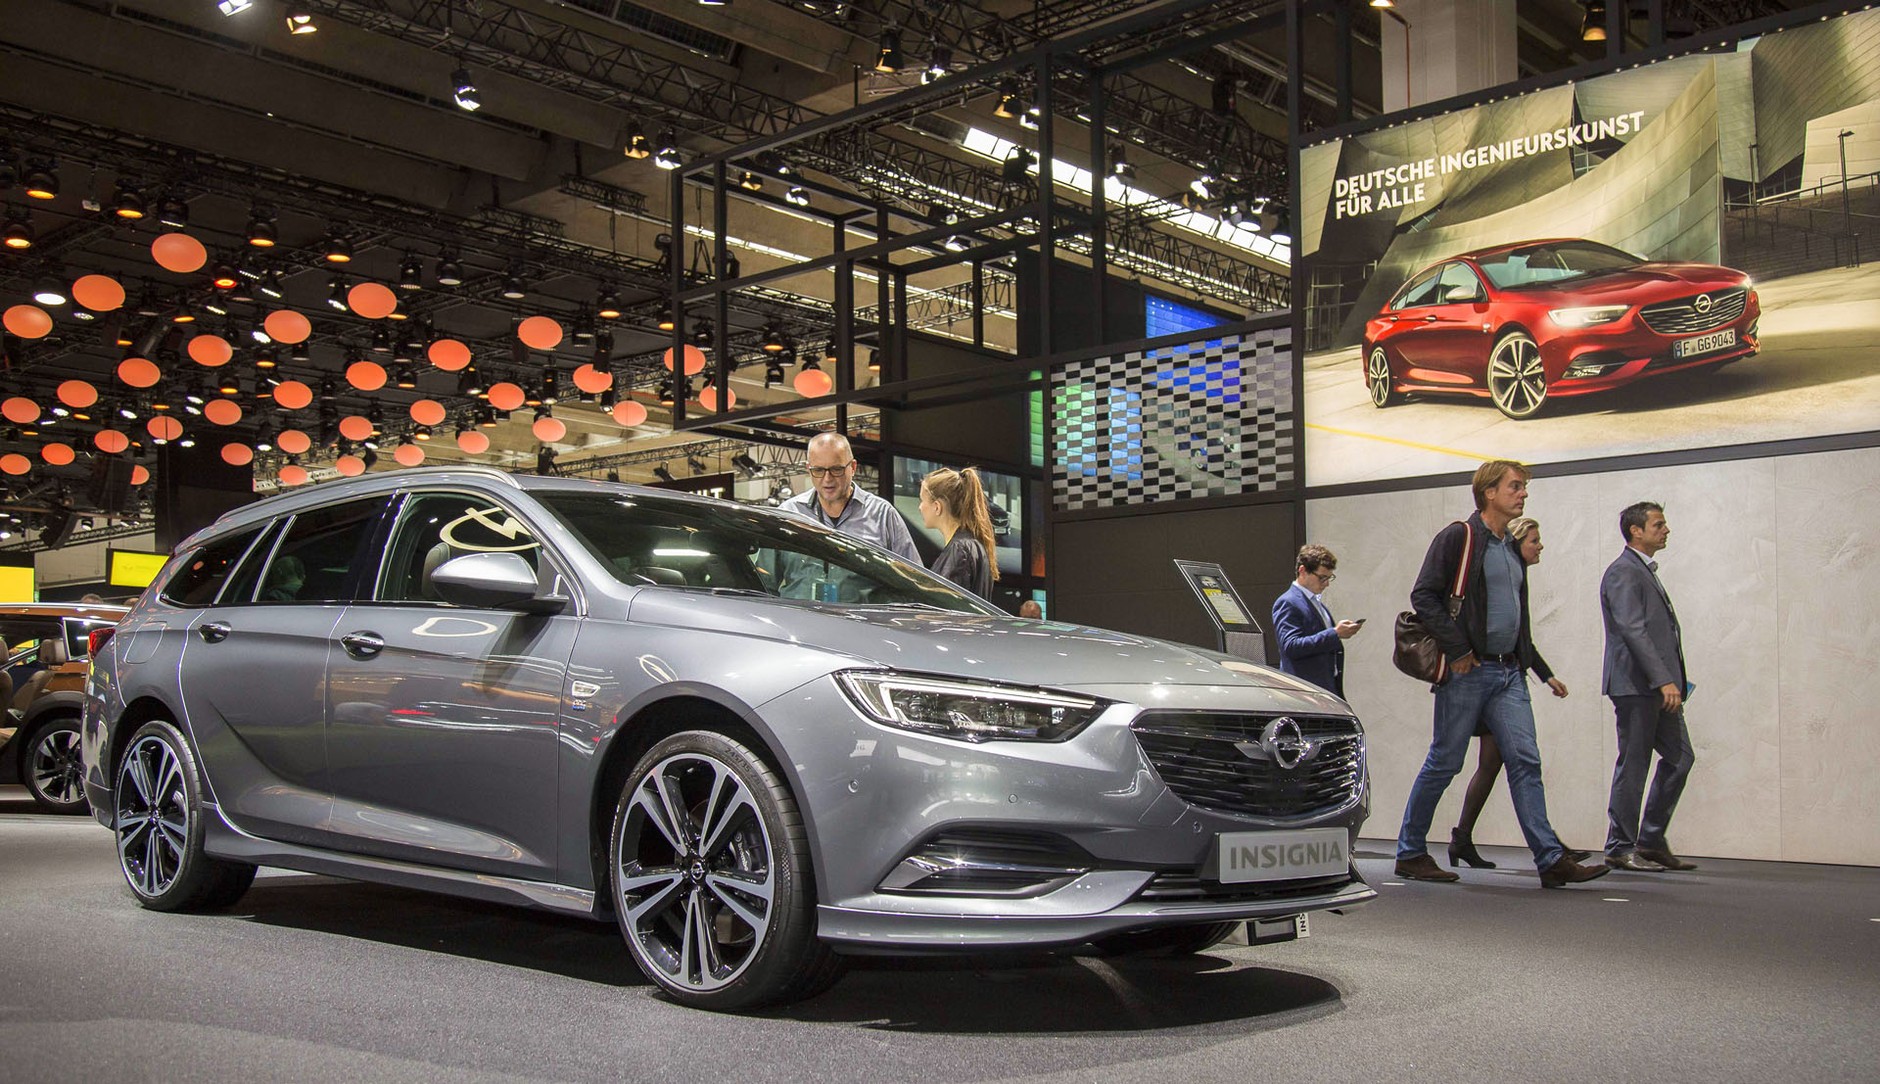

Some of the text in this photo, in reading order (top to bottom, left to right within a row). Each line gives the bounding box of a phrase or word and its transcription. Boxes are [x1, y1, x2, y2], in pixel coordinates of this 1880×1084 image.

[1335, 111, 1645, 198] DEUTSCHE INGENIEURSKUNST
[1336, 183, 1425, 219] FÜR ALLE
[1230, 841, 1343, 870] INSIGNIA
